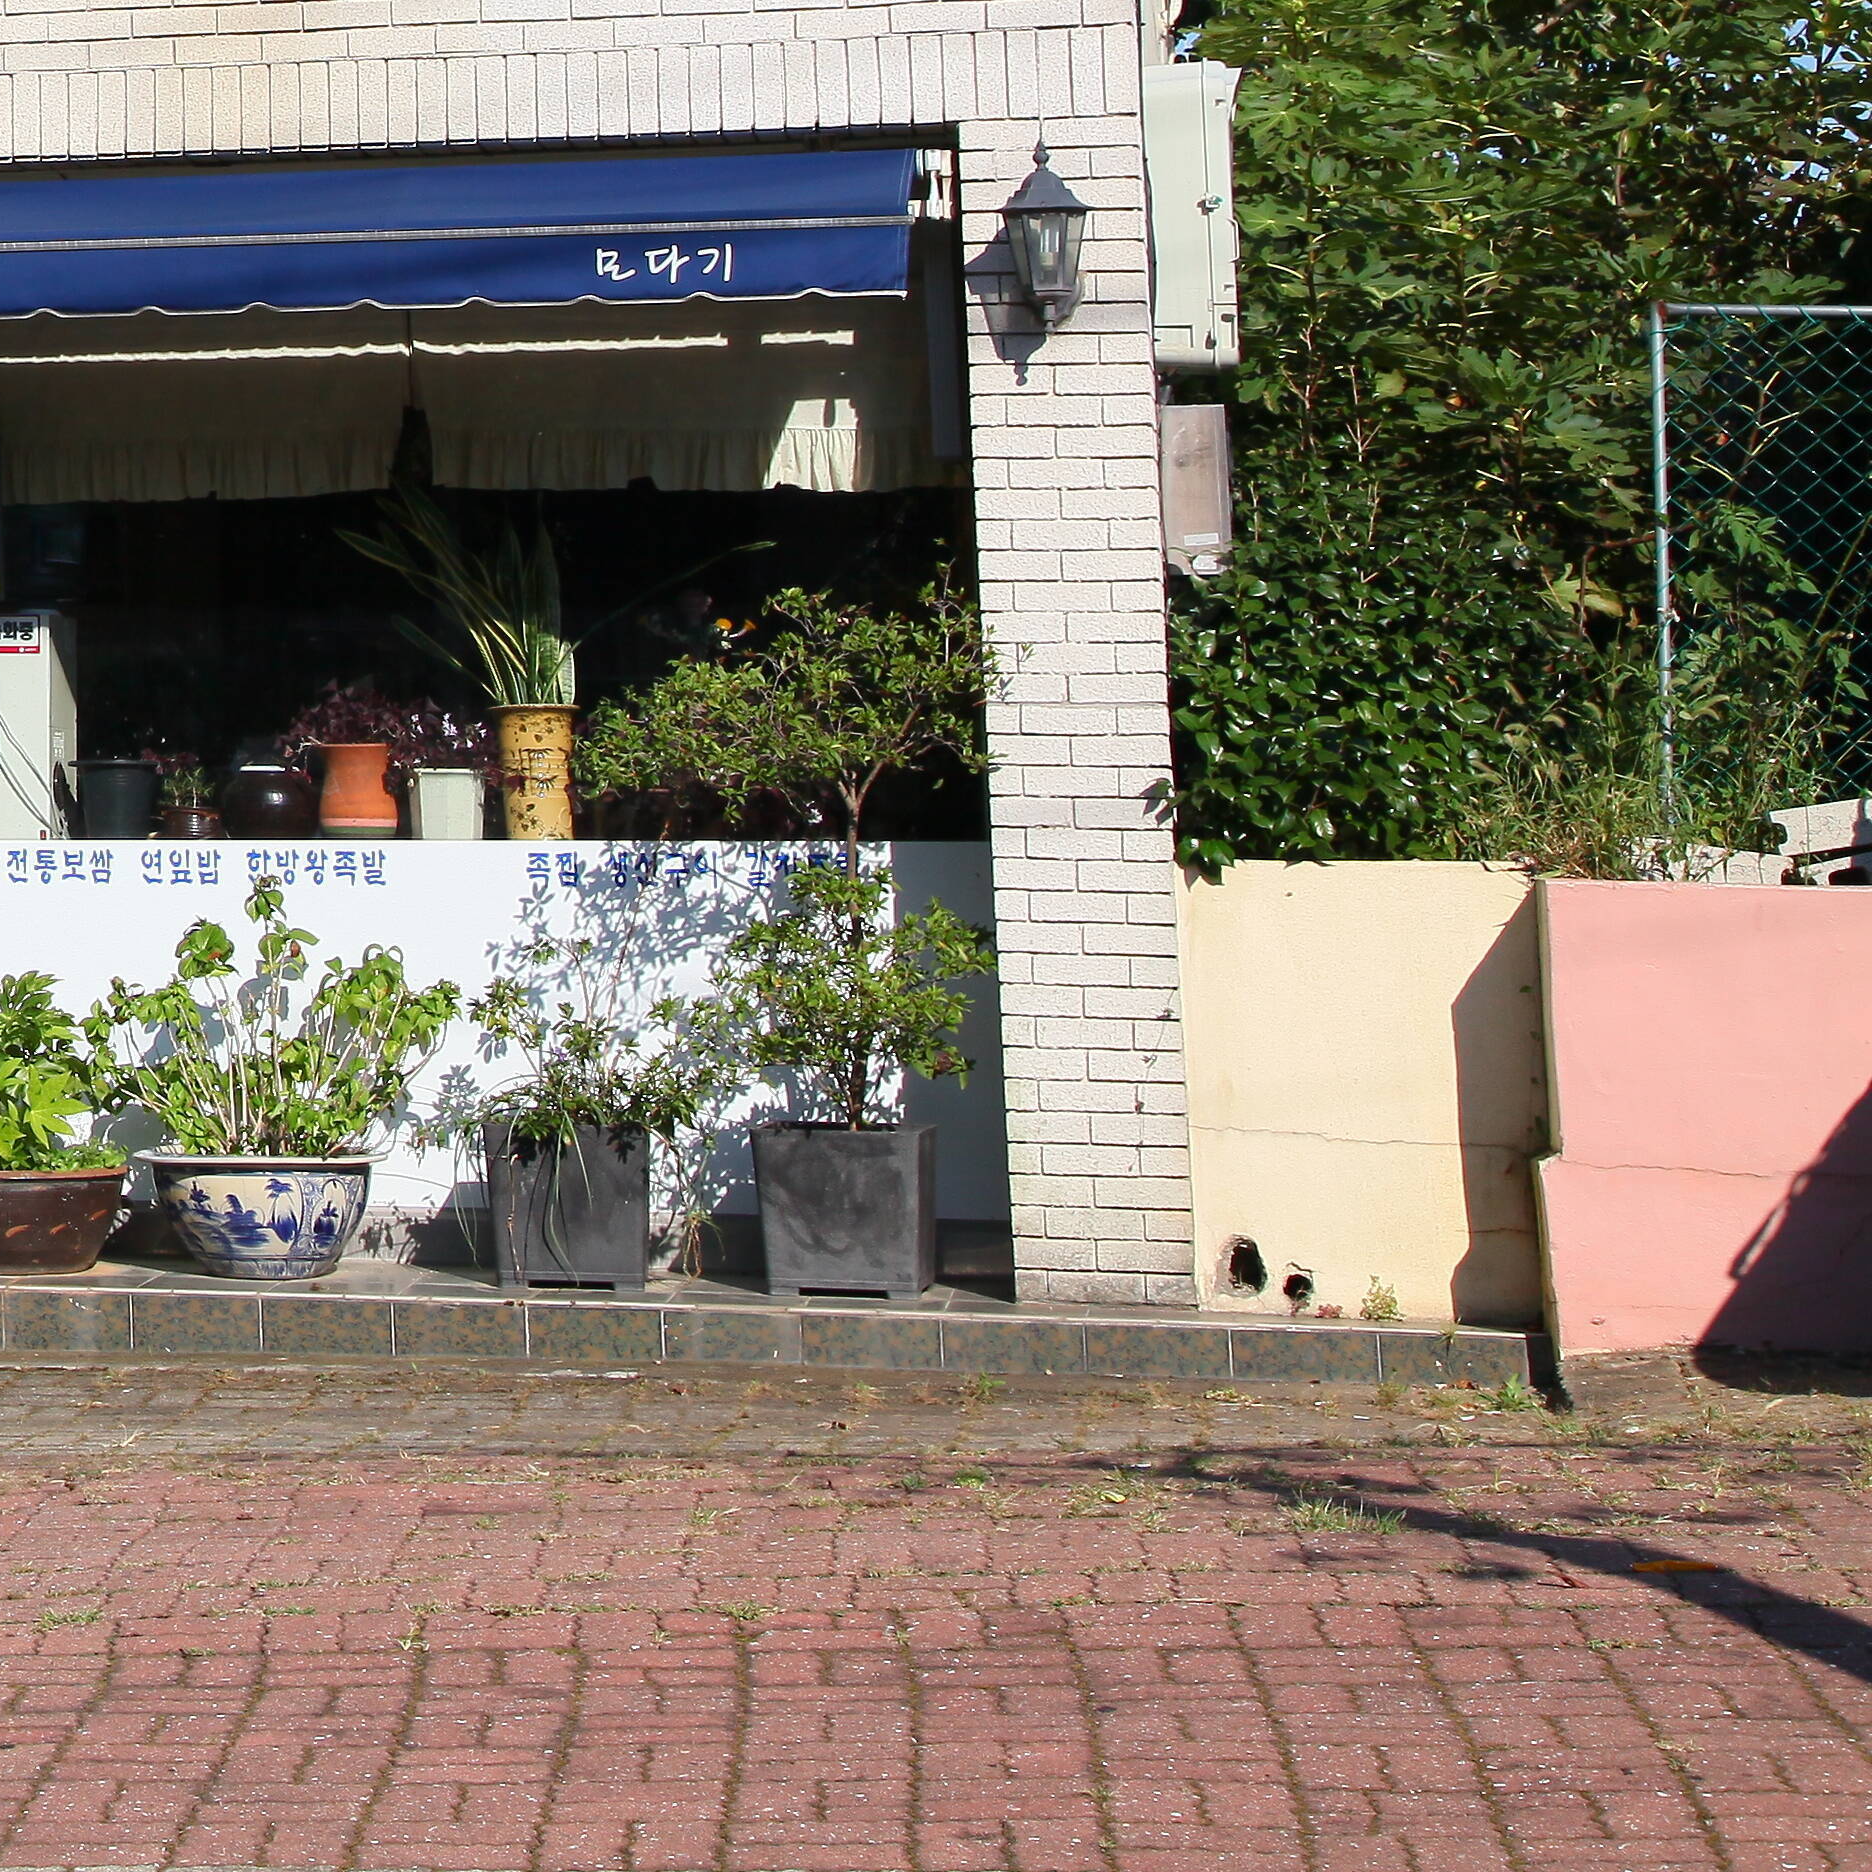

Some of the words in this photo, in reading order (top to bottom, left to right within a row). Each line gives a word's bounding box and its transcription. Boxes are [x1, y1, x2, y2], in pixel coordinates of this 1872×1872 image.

[6, 848, 115, 886] 전통보쌈
[141, 848, 222, 886] 연잎밥
[526, 850, 579, 888] 족찜
